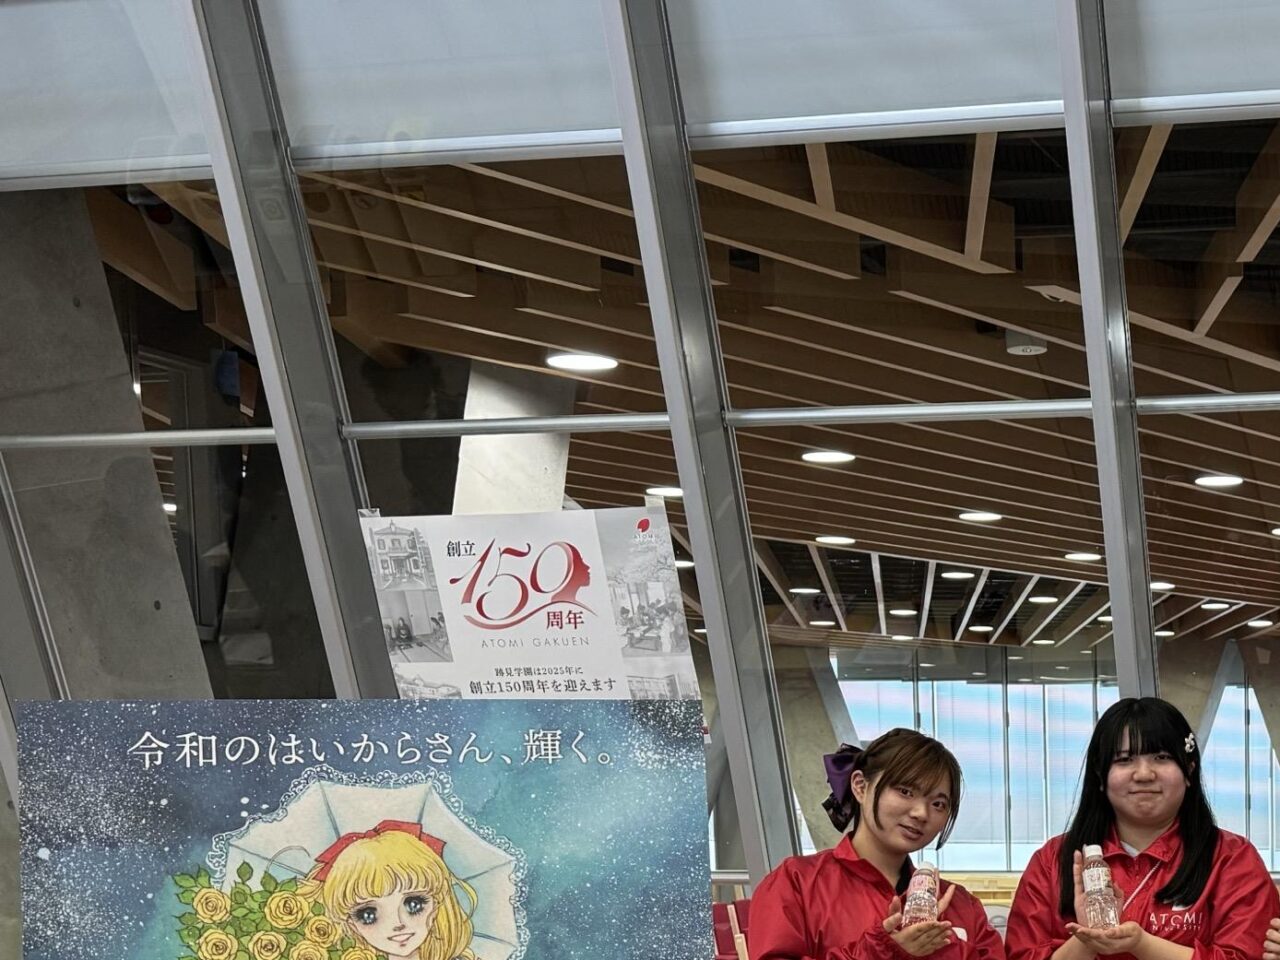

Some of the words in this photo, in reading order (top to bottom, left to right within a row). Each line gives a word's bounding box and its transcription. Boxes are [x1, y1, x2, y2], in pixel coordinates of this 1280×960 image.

[447, 540, 476, 558] 創立
[546, 610, 585, 630] 周年
[481, 638, 524, 649] ATOMI
[532, 636, 590, 648] GAKUEN
[494, 665, 584, 678] 跡見学園は2025年に
[469, 677, 617, 695] 創立150周年を迎えます
[127, 728, 613, 769] 令和のはいからさん、輝く。
[1149, 912, 1203, 926] ATOMI
